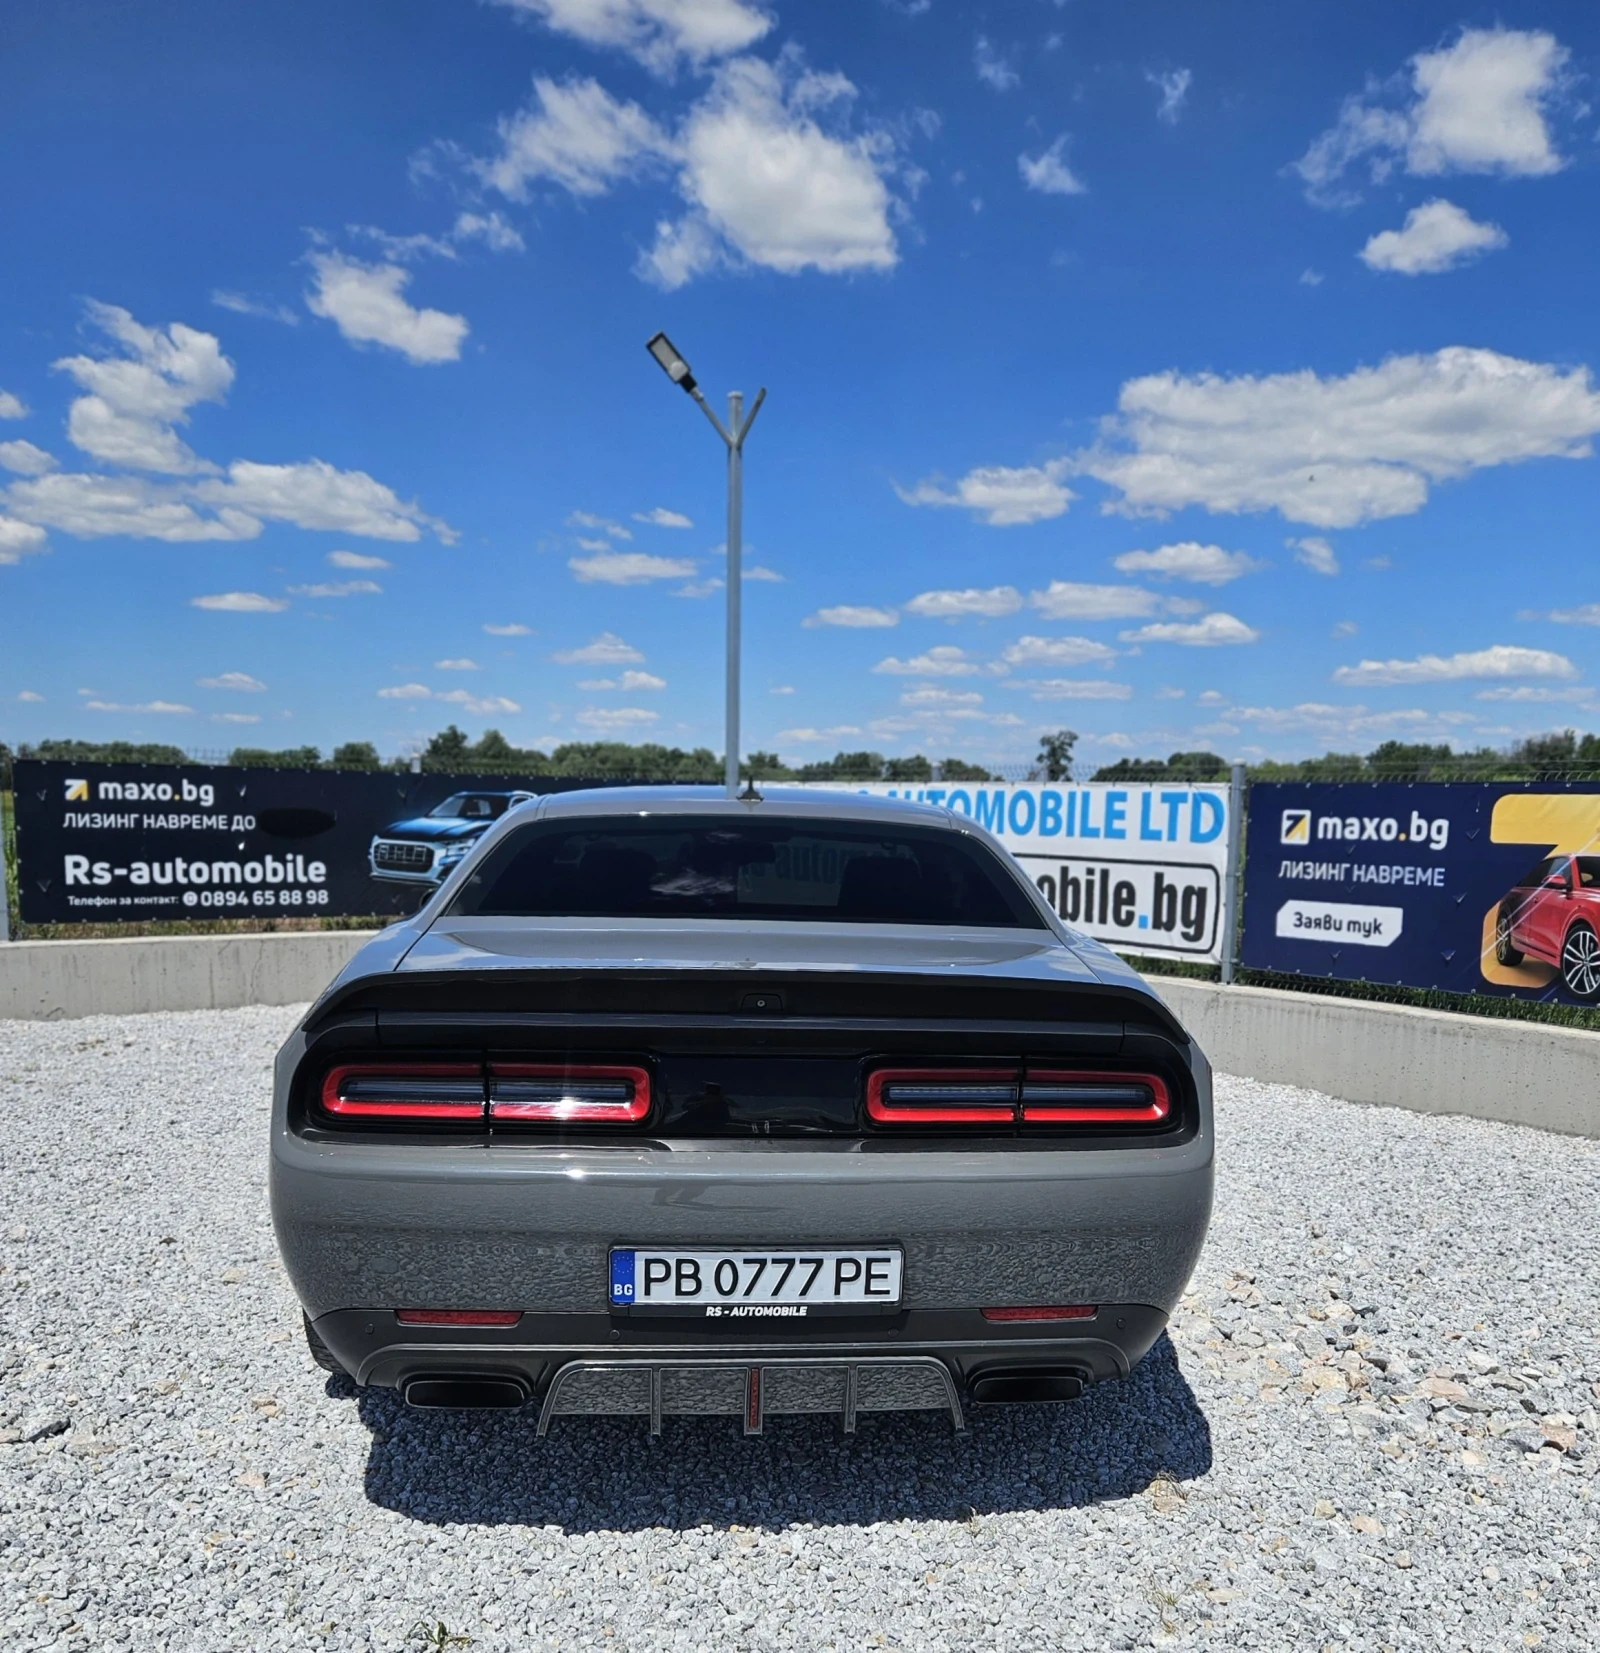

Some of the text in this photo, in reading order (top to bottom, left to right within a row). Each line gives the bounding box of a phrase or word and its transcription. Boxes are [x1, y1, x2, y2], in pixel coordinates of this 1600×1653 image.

[99, 778, 215, 806] maxo.bg
[62, 812, 256, 832] ЛИЗИНГ НАВРЕМЕ ДО
[887, 788, 1226, 844] OMOBILE LTD
[1317, 810, 1450, 850] maxo.bg
[64, 854, 328, 886] Rs-automobile
[1278, 860, 1446, 887] ЛИЗИНГ НАВРЕМЕ
[67, 889, 329, 907] Телефон за контакт: 0894 65 88 98
[1036, 865, 1208, 943] obile.bg
[1292, 911, 1343, 932] Заяви
[613, 1284, 633, 1296] BG
[643, 1258, 892, 1297] PB 0777 PE
[731, 1305, 808, 1317] AUTOMOBILE
